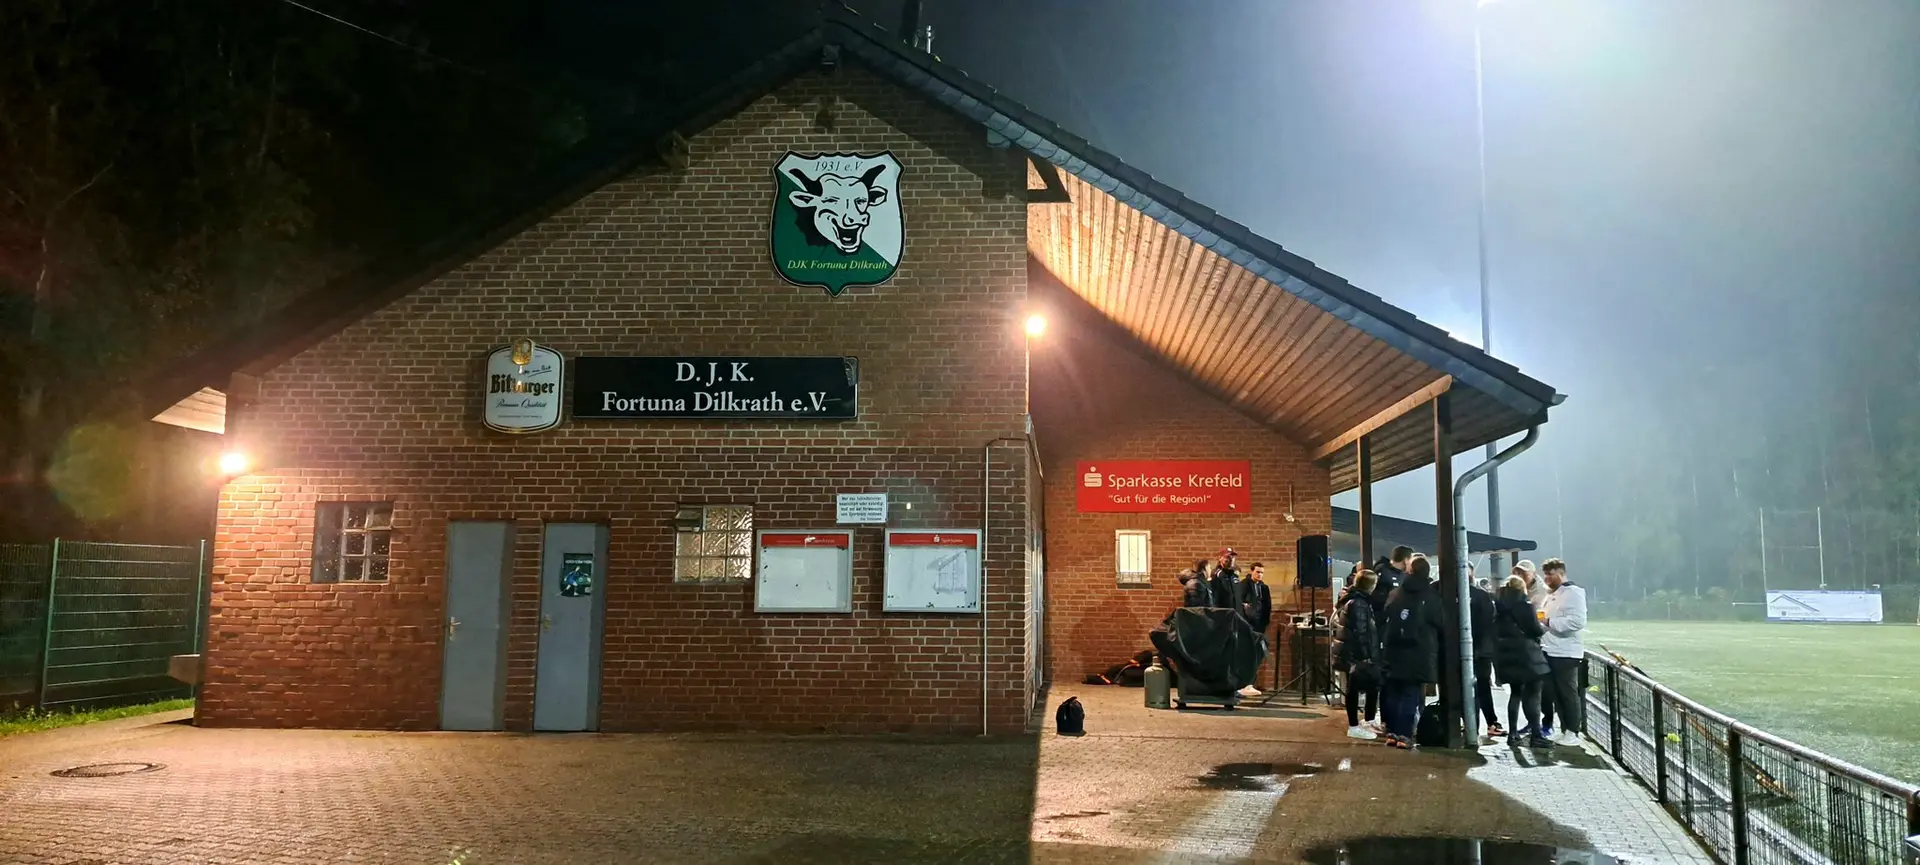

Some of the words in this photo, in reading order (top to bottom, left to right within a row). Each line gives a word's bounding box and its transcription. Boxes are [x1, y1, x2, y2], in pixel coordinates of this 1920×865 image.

[815, 161, 840, 171] 1931
[844, 161, 864, 171] e.V.
[787, 260, 808, 269] DJK
[810, 260, 847, 269] Fortuna
[849, 260, 888, 269] Dilkrath
[675, 362, 701, 382] D.
[705, 362, 723, 387] J.
[731, 362, 755, 382] K.
[602, 391, 685, 412] Fortuna
[693, 391, 784, 412] Dilkrath
[791, 391, 827, 412] e.V.
[1108, 474, 1182, 491] Sparkasse
[1188, 473, 1243, 488] Krefeld
[1135, 495, 1149, 504] für
[1152, 495, 1167, 504] die
